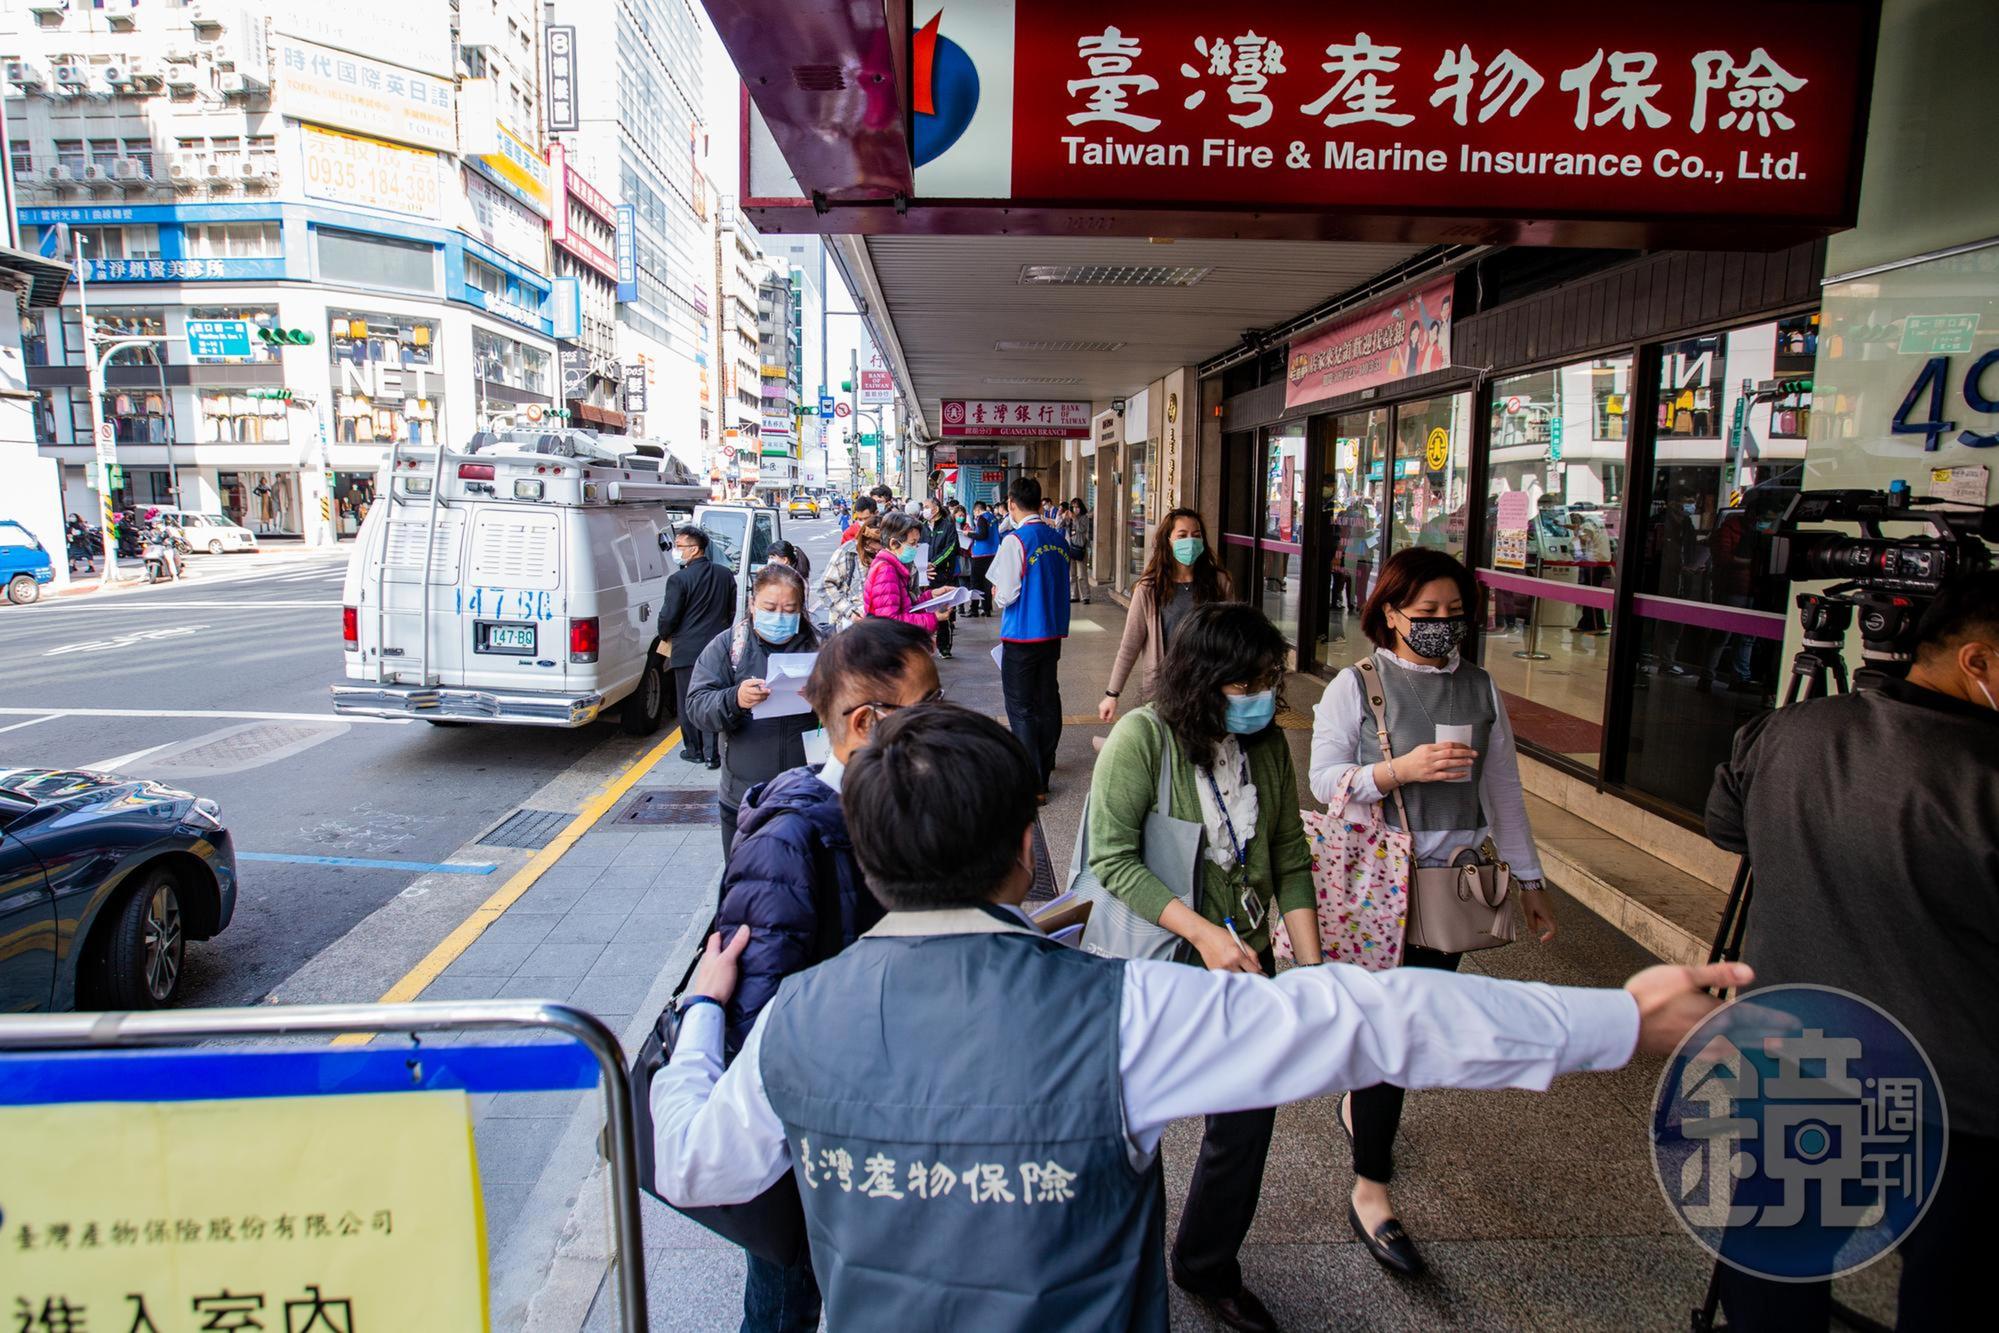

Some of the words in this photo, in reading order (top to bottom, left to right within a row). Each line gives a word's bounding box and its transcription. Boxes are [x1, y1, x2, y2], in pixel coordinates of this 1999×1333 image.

[1062, 26, 1808, 137] 臺灣產物保險
[1061, 137, 1189, 166] Taiwan
[1202, 139, 1274, 168] Fire
[1285, 141, 1312, 169] &
[1324, 141, 1448, 172] Marine
[1460, 144, 1642, 177] Insurance
[1653, 149, 1724, 184] Co.,
[1738, 150, 1807, 180] Ltd.
[340, 357, 443, 399] NET
[972, 402, 1055, 424] 臺灣銀行
[1060, 404, 1081, 412] BANK
[1060, 417, 1088, 425] TAIWAN
[1037, 427, 1068, 437] BRANCH
[13, 1210, 395, 1252] 臺灣產物保險股份有限公司
